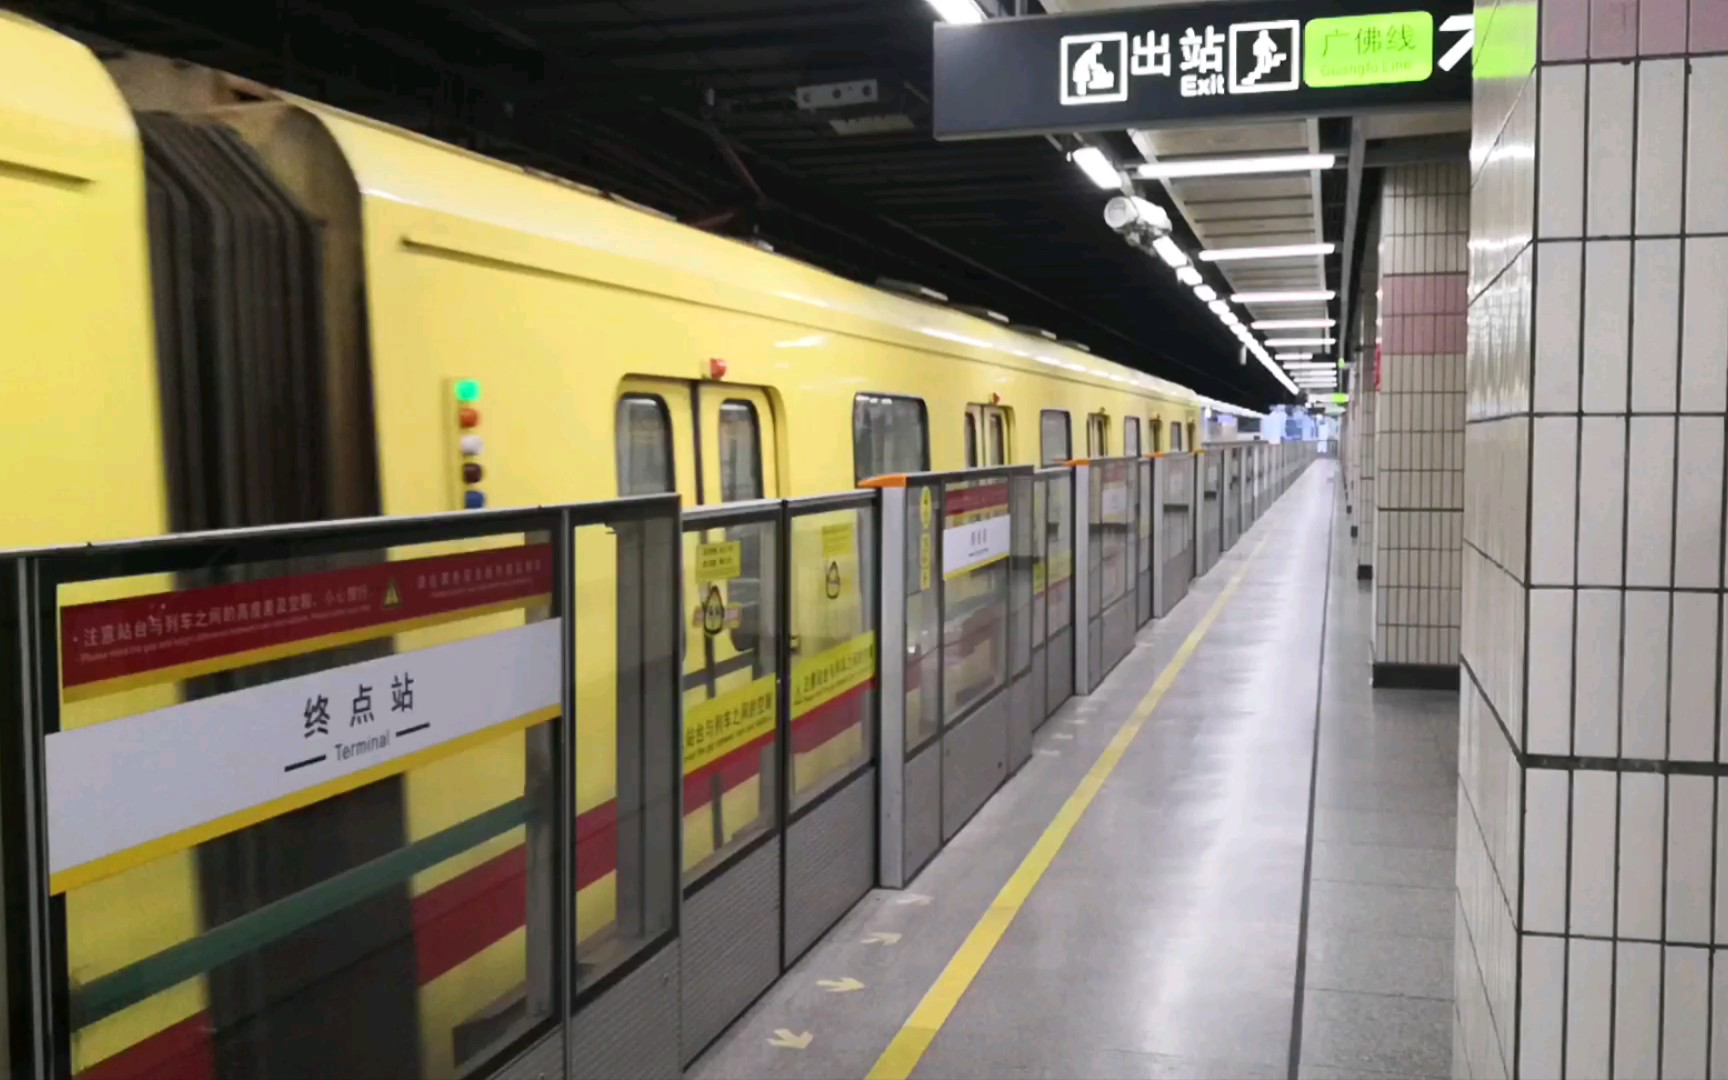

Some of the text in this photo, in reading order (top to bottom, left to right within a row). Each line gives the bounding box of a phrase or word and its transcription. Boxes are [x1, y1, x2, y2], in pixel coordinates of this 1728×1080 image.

[1131, 25, 1225, 76] 出站
[1321, 23, 1417, 58] 广佛线
[1382, 59, 1412, 73] Line
[1180, 74, 1225, 97] Exit
[303, 672, 416, 739] 终点站
[333, 731, 391, 763] Terminal
